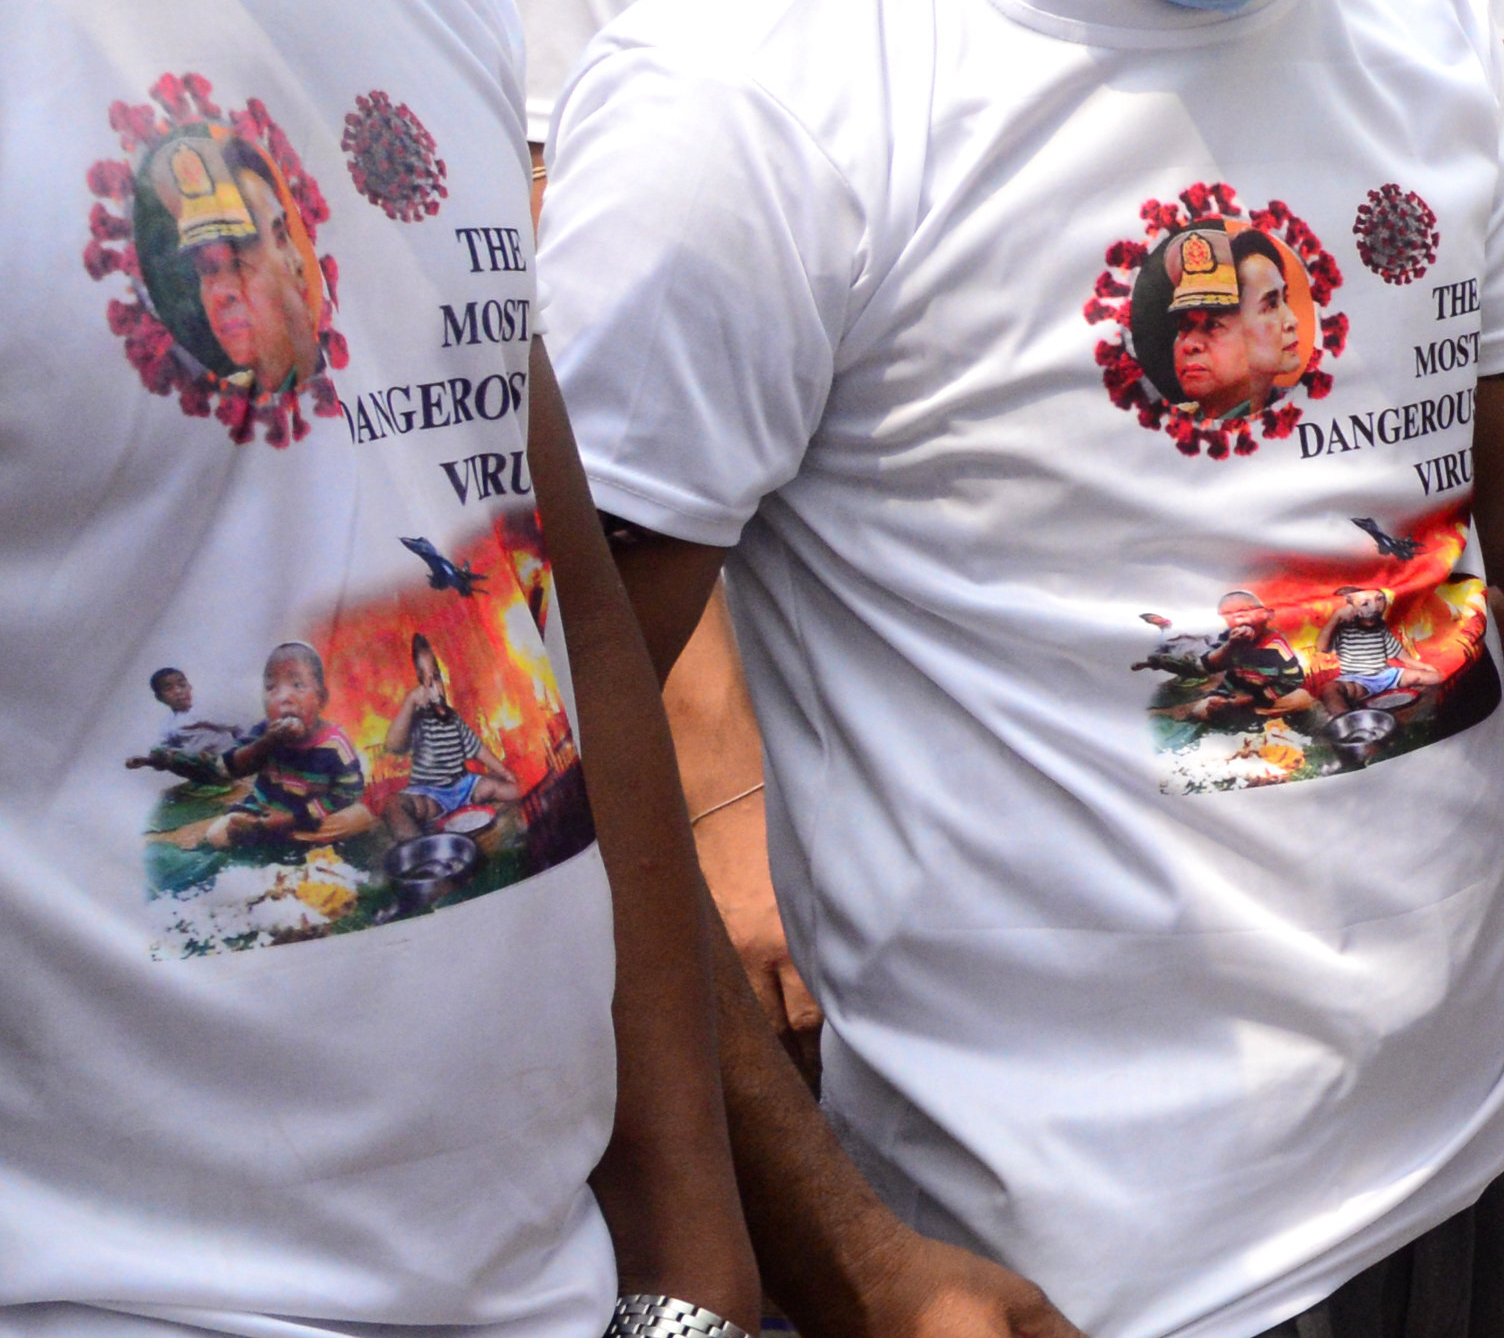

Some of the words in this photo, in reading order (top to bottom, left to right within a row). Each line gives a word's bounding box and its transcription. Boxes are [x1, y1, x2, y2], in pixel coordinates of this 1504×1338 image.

[455, 227, 526, 272] THE
[1432, 277, 1480, 320] THE
[439, 299, 530, 348] MOST
[1414, 330, 1480, 378] MOST
[1297, 386, 1477, 459] DANGEROU
